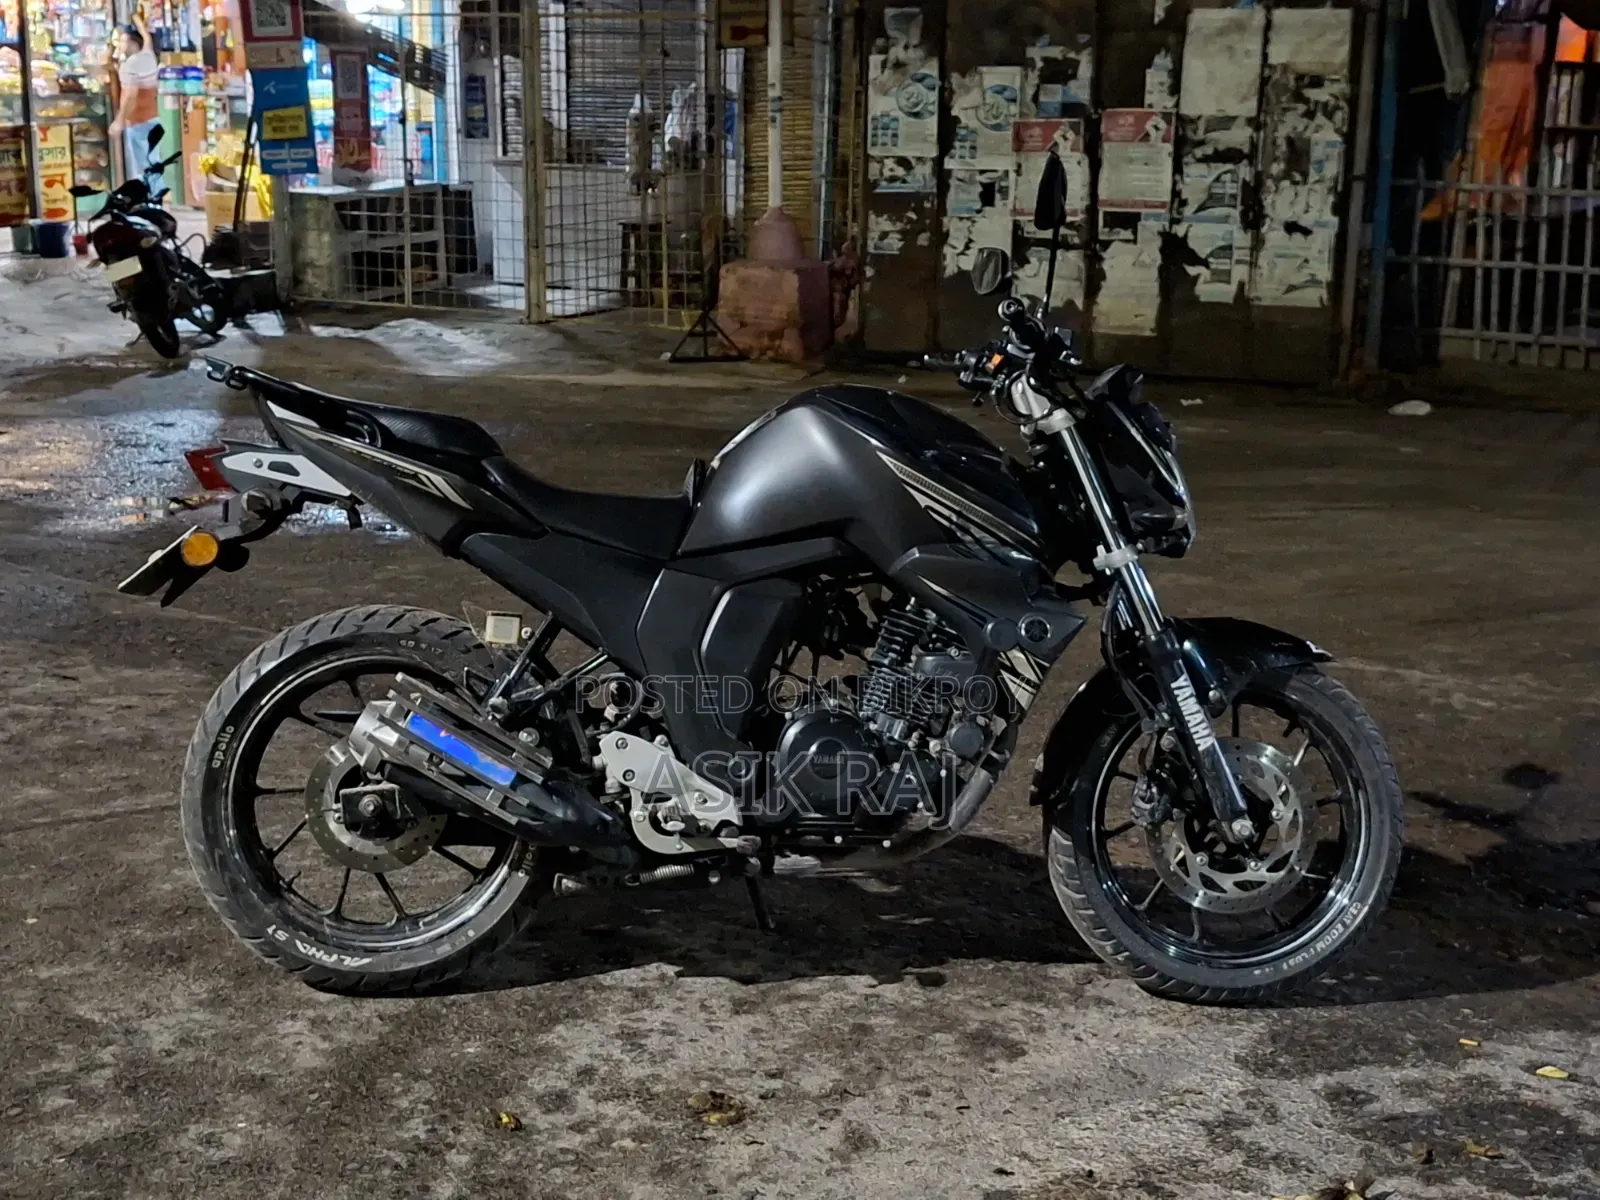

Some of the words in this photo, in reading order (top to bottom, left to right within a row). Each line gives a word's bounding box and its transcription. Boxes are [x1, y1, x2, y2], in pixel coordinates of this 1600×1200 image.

[1170, 673, 1215, 752] YAMAHA
[211, 725, 235, 768] apollo
[295, 938, 373, 968] ALPHA
